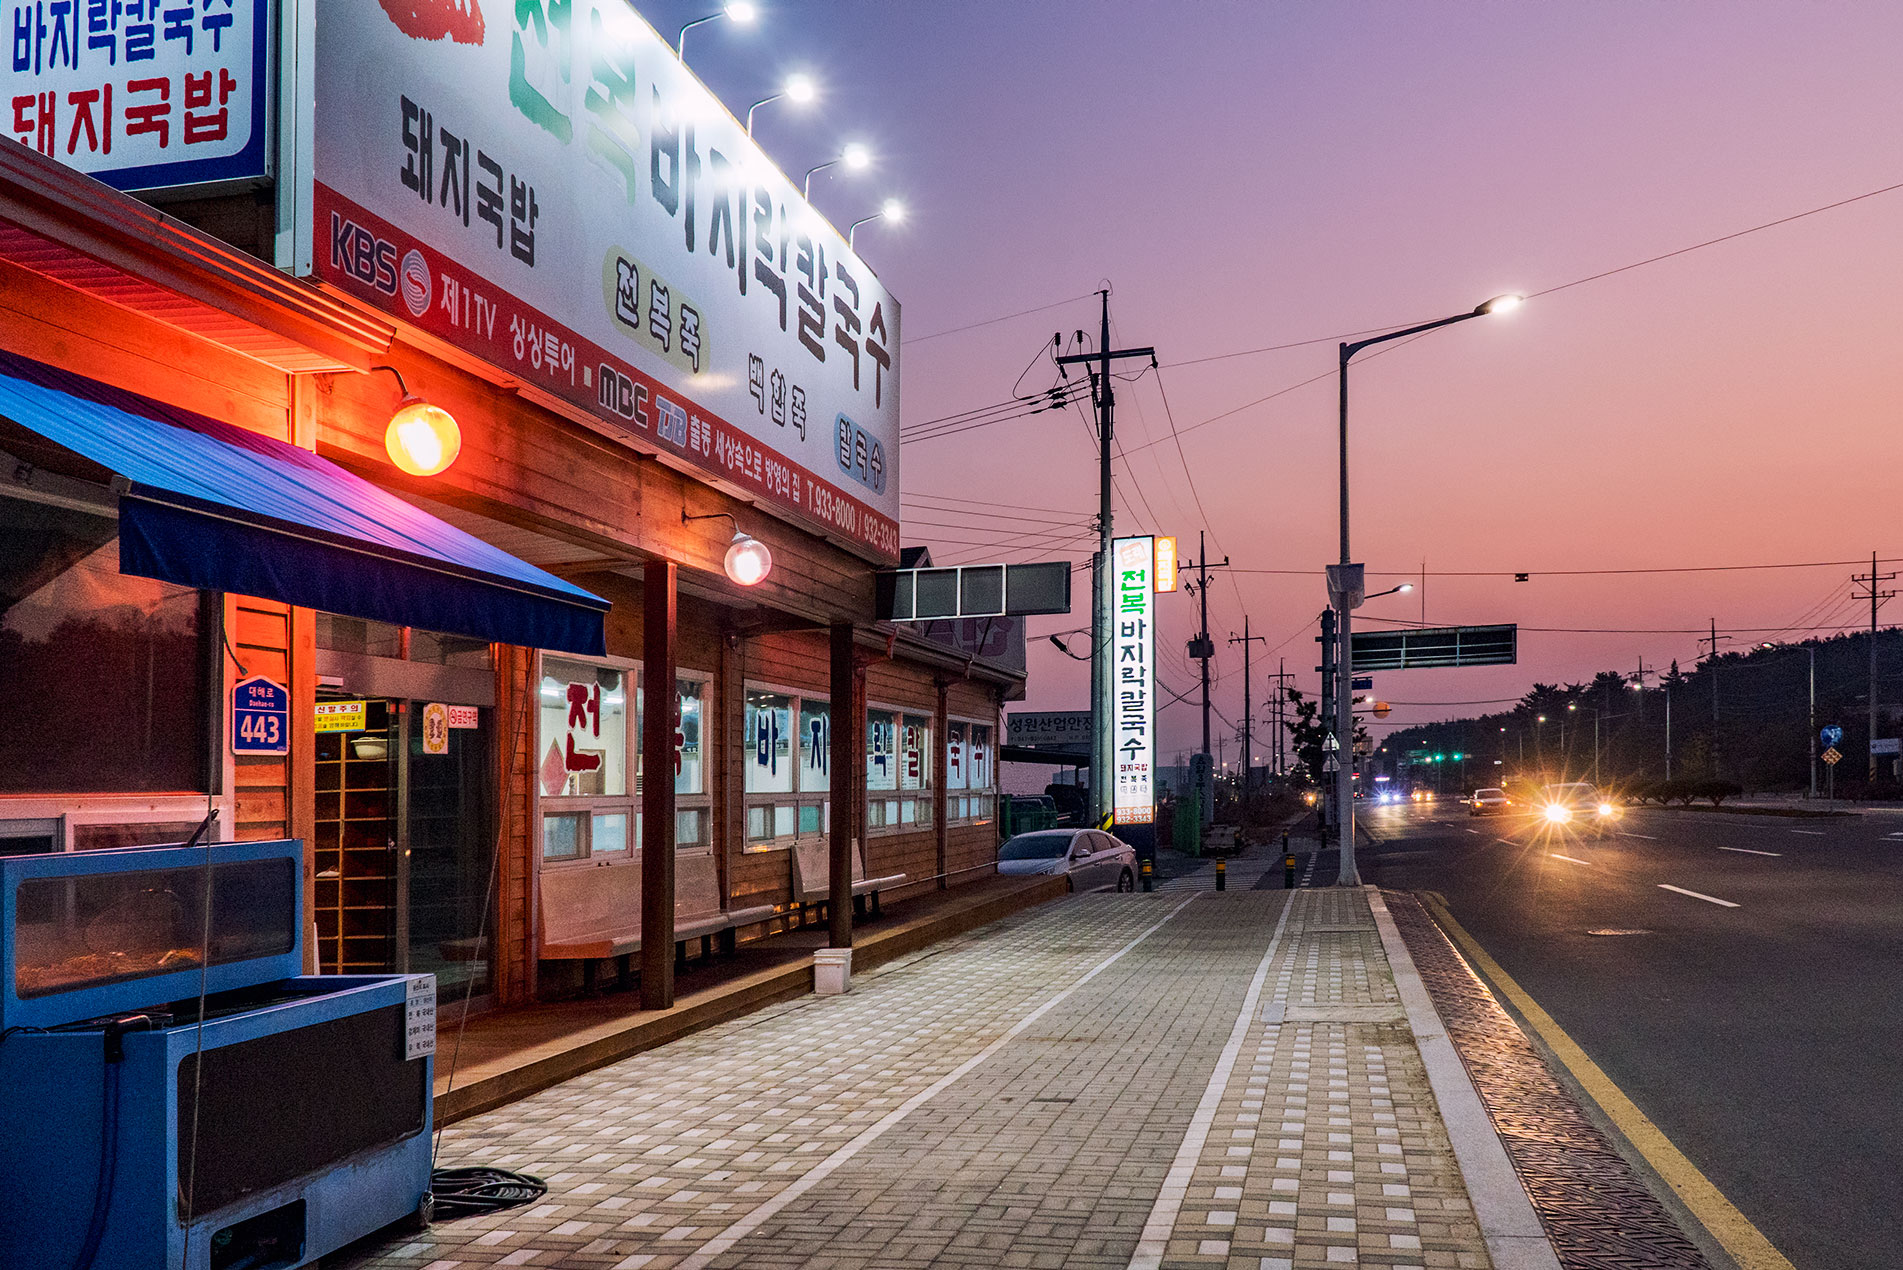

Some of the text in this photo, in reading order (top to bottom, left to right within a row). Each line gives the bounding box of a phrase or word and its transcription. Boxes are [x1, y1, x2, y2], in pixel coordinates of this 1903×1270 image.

[12, 0, 235, 76] 바지락칼국수
[11, 70, 236, 159] 돼지국밥
[400, 94, 540, 268] 돼지국밥
[616, 256, 700, 374] 전복죽
[331, 210, 397, 297] KBS
[655, 395, 687, 449] TJB
[690, 414, 712, 458] 출동
[715, 429, 762, 482] 세상속으로
[864, 514, 898, 556] 932-3343
[839, 418, 882, 490] 칼국수
[1120, 569, 1146, 614] 전복
[248, 686, 275, 698] 대해로
[1120, 618, 1147, 761] 바지락칼국수
[240, 715, 280, 743] 443
[1116, 807, 1151, 816] 933-8000
[1116, 815, 1151, 824] 932-3343
